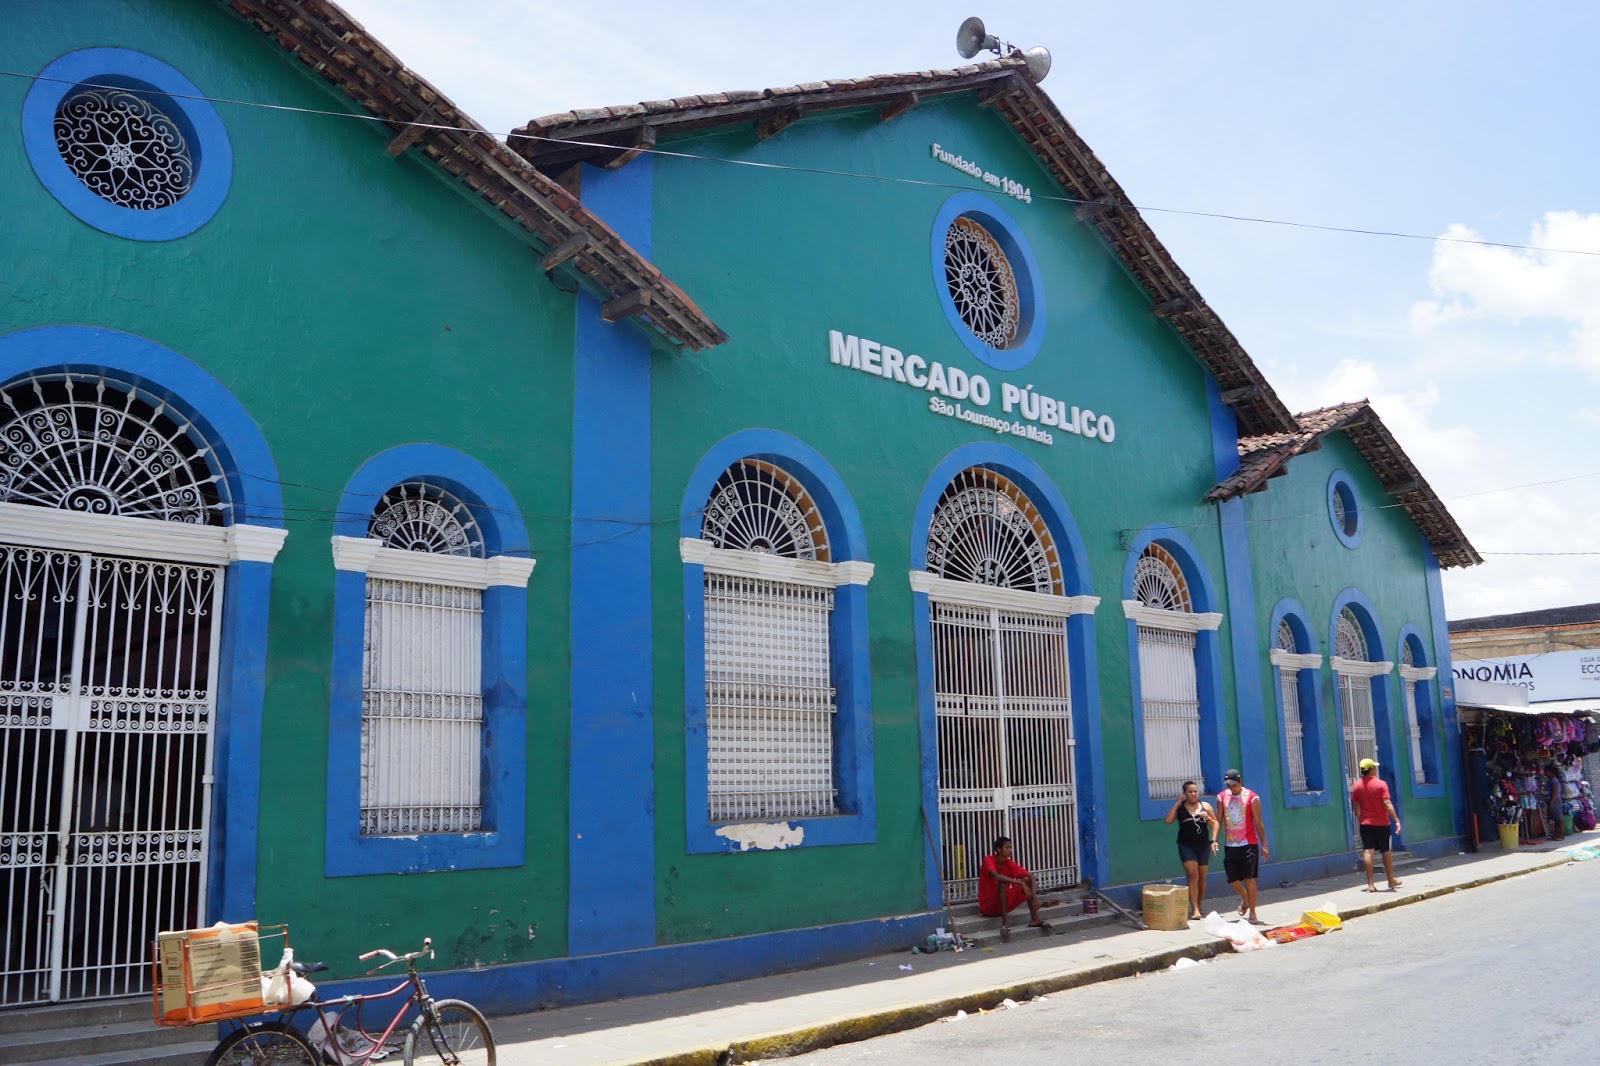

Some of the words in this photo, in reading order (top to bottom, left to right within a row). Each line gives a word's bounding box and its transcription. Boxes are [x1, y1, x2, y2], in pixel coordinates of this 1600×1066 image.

[931, 143, 982, 178] Fundado
[982, 171, 1000, 188] em
[1000, 176, 1032, 204] 1904
[828, 329, 991, 407] MERCADO
[1001, 382, 1116, 443] PÚBLICO
[929, 396, 954, 417] São
[955, 403, 1011, 434] Lourenço
[1011, 421, 1027, 438] da
[1026, 425, 1053, 446] Mata
